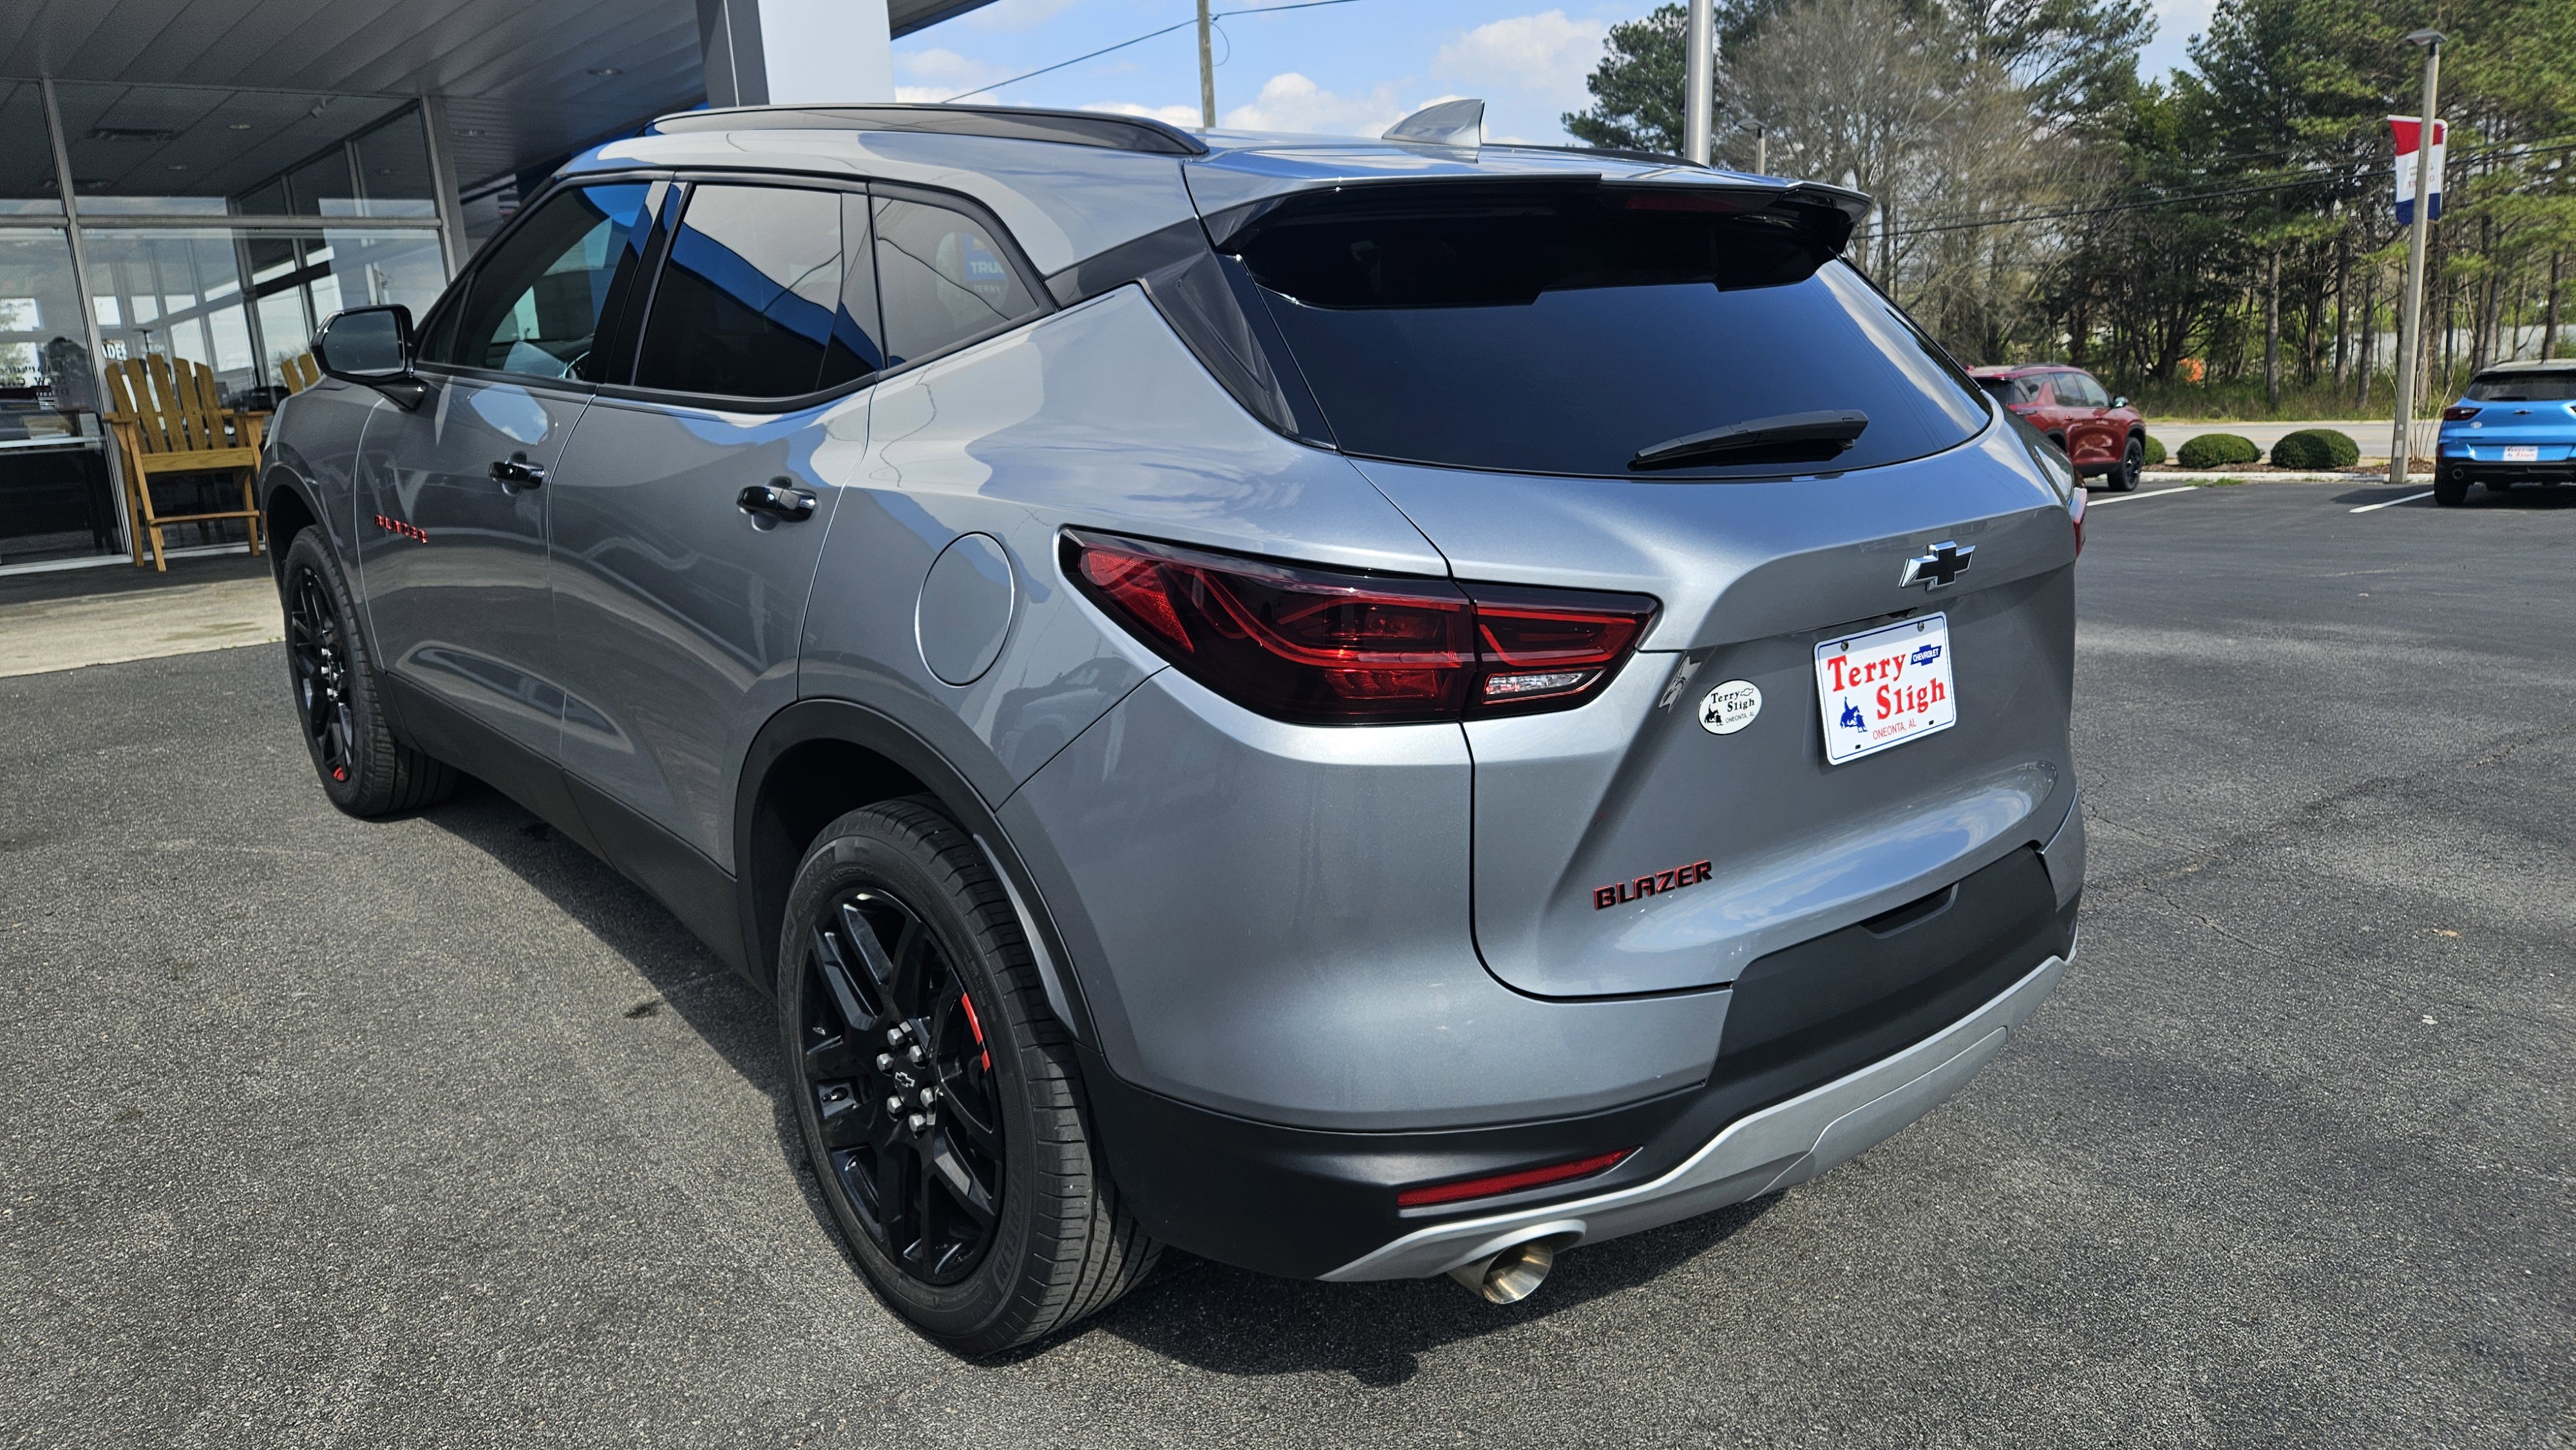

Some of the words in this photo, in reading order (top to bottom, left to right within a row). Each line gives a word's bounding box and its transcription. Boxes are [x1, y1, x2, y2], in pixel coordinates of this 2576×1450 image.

[375, 514, 428, 543] BLAZER
[1913, 648, 1939, 662] CHEVROLET
[1828, 654, 1906, 692] Terry
[1711, 691, 1740, 704] Terry
[1727, 699, 1755, 712] Sligh
[1877, 677, 1946, 720] Sligh
[1873, 722, 1906, 740] ONEONTA,
[1909, 717, 1917, 729] AL
[1594, 860, 1713, 910] BLAZER
